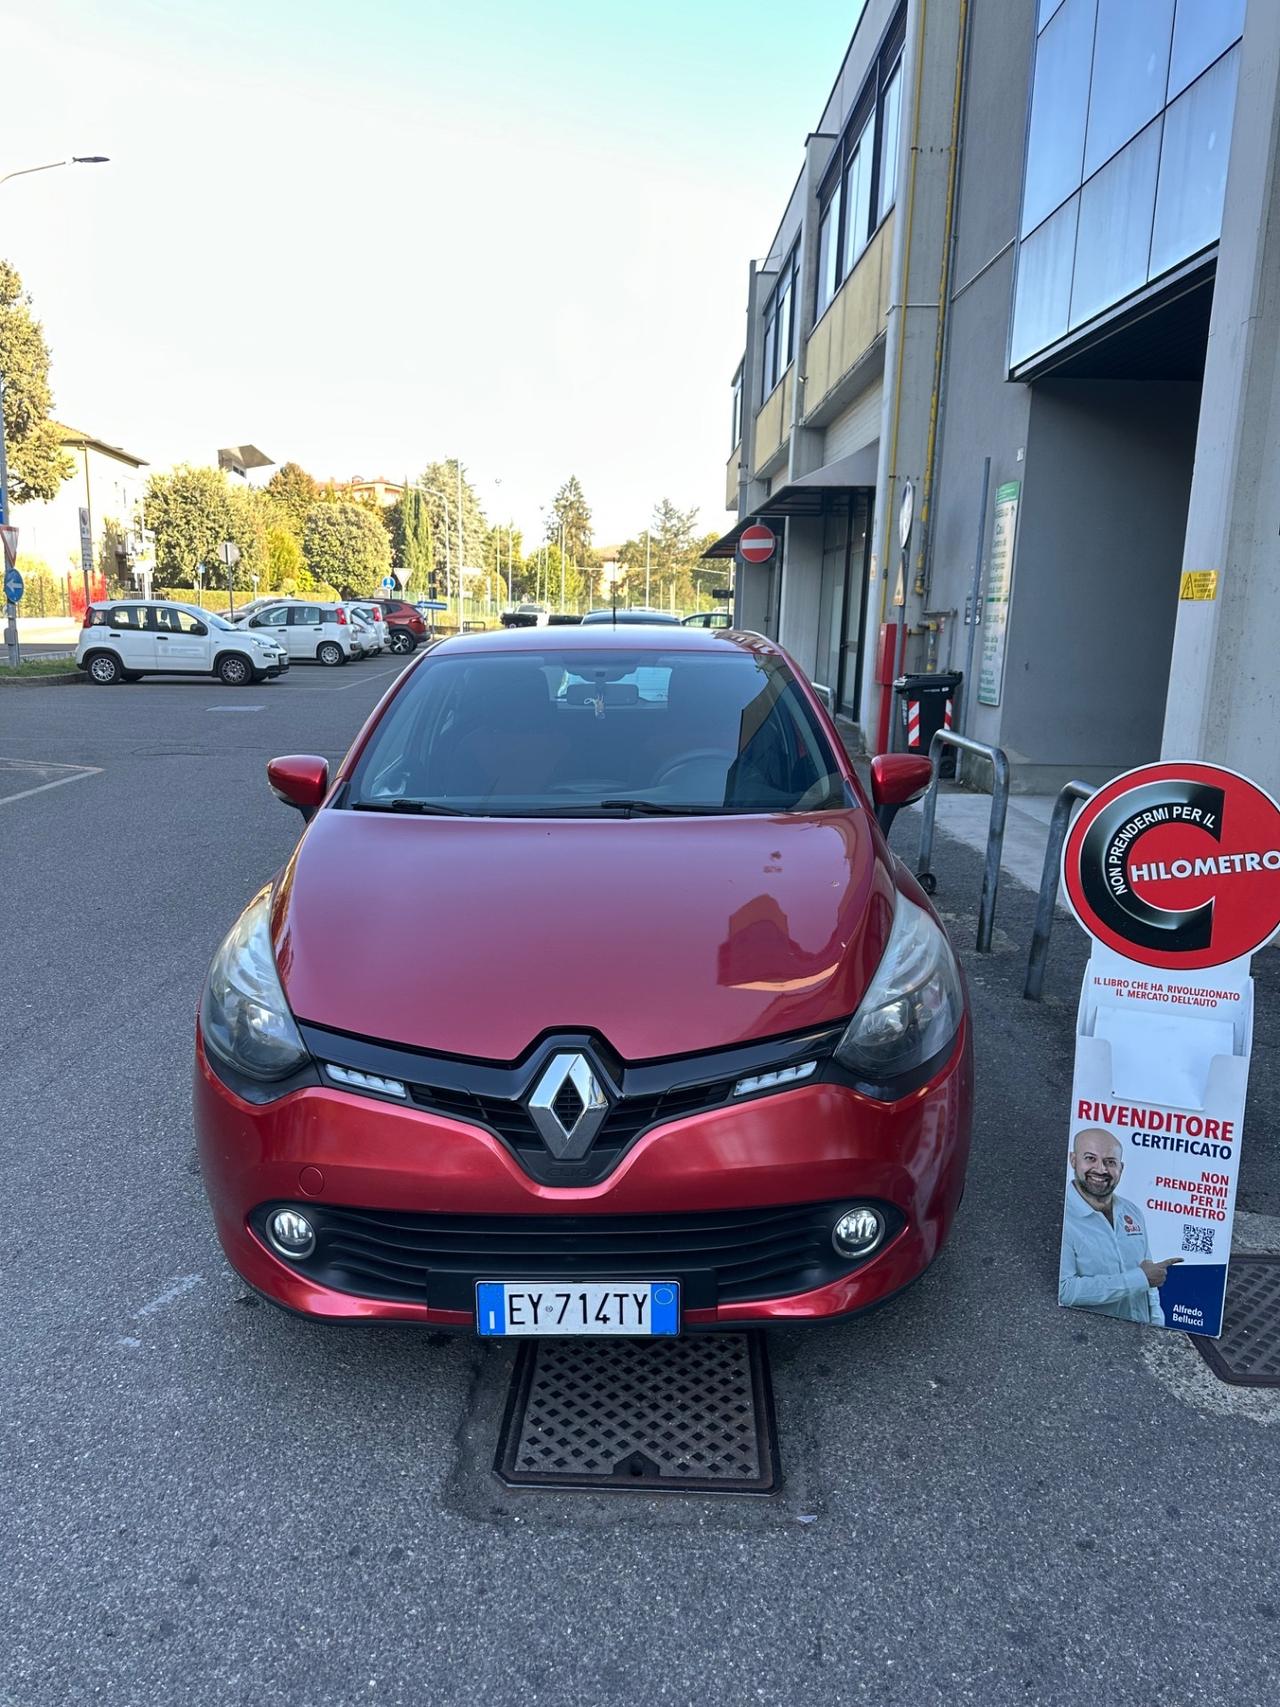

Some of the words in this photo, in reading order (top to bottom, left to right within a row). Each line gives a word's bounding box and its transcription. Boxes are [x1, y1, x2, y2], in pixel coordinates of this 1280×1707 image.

[1172, 806, 1202, 821] PER
[1203, 814, 1215, 828] IL
[1109, 807, 1169, 864] PRENDERMI
[1108, 864, 1128, 895] NON
[1094, 976, 1102, 986] IL
[1103, 978, 1129, 989] LIBRO
[1131, 980, 1149, 991] CHE
[1151, 982, 1163, 992] HA
[1167, 984, 1241, 1001] RIVOLUZIONATO
[1115, 989, 1124, 998] IL
[1127, 990, 1169, 1003] MERCATO
[1171, 994, 1218, 1008] DELL'AUTO
[1078, 1100, 1235, 1143] RIVENDITORE
[1131, 1132, 1233, 1160] CERTIFICATO
[1155, 1177, 1228, 1198] PRENDERMI
[1201, 1171, 1229, 1186] NON
[1147, 1199, 1226, 1222] CHILOMETRO
[1190, 1194, 1213, 1209] PER
[1216, 1198, 1228, 1210] IL
[1172, 1313, 1204, 1327] Bellucci
[1173, 1304, 1203, 1317] Alfredo
